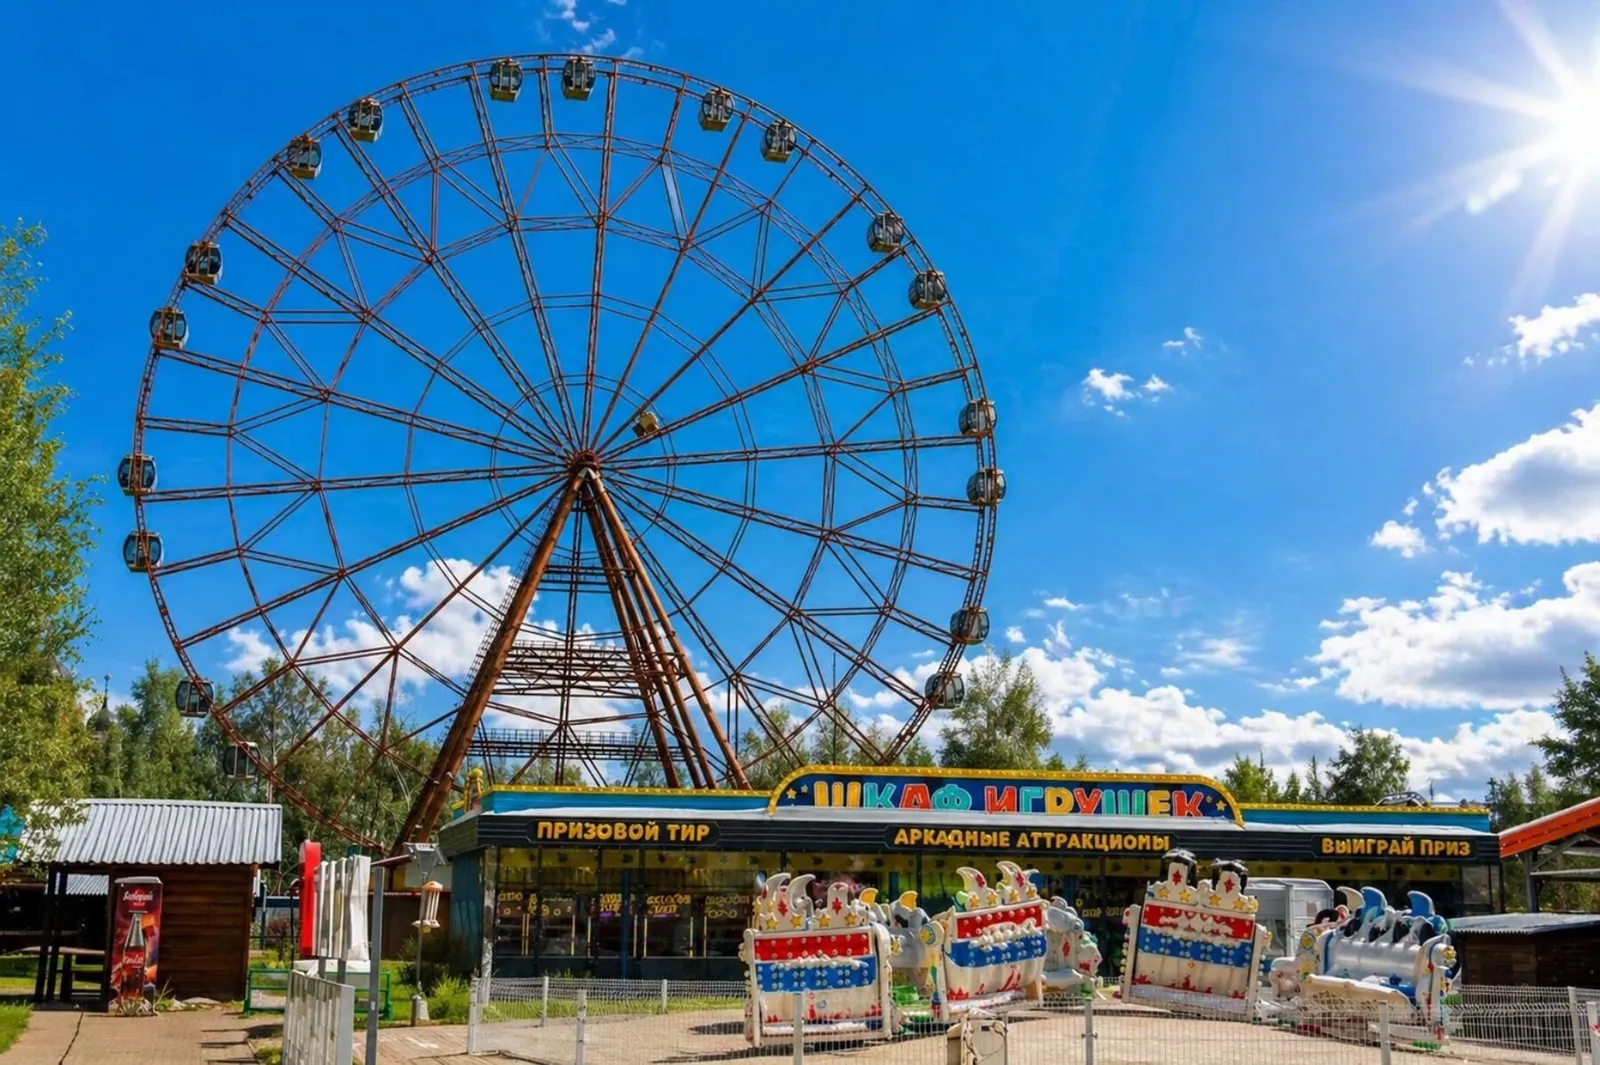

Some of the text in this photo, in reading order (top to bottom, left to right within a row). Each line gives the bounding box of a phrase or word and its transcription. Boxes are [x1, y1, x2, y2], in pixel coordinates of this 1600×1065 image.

[814, 781, 1204, 818] ШКАФ ИГРУШЕК
[537, 821, 710, 841] ПРИЗОВОЙ ТИР
[894, 828, 1170, 851] АРКАДНЫЕ АТТРАКЦИОНЫ
[1321, 836, 1471, 856] ВЫИГРАЙ ПРИЗ
